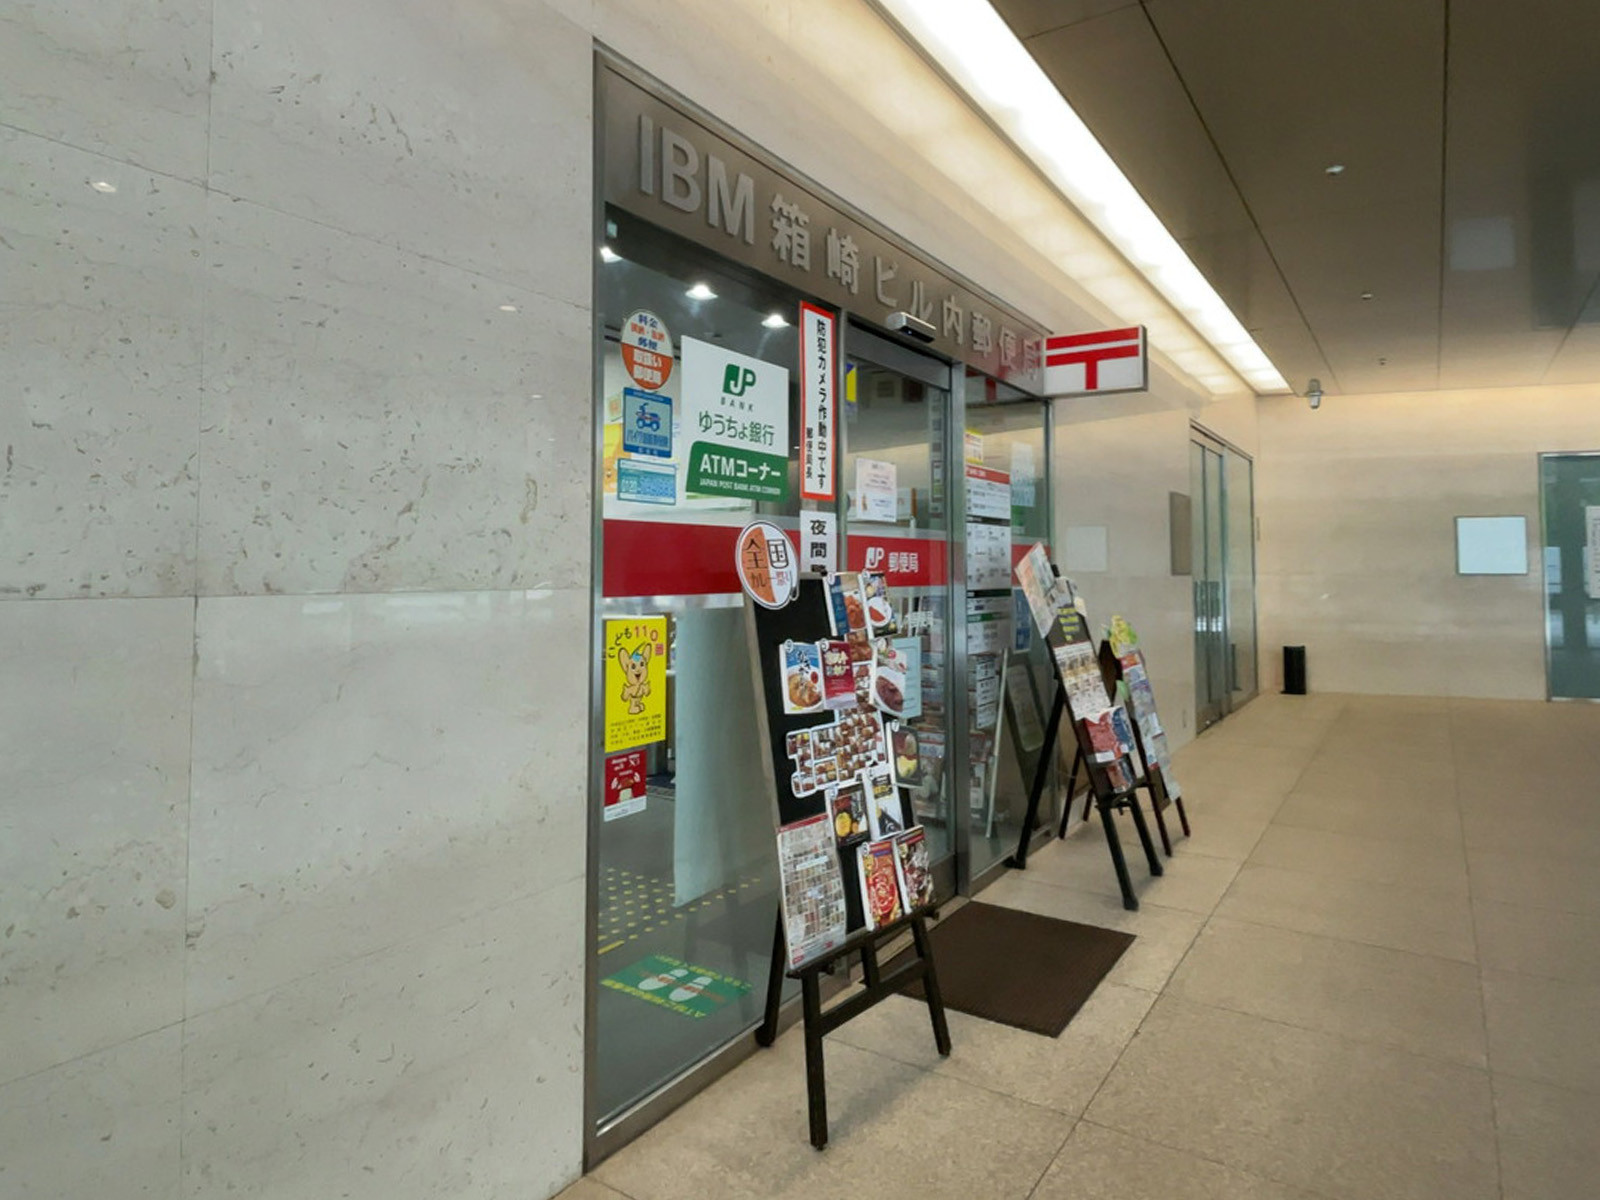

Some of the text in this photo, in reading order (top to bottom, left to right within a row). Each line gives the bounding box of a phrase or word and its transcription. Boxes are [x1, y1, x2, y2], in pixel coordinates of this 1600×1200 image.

[721, 396, 754, 412] BANK
[699, 410, 775, 446] ゆうちょ銀行
[700, 453, 781, 481] ATMコーナー
[719, 480, 733, 489] POST
